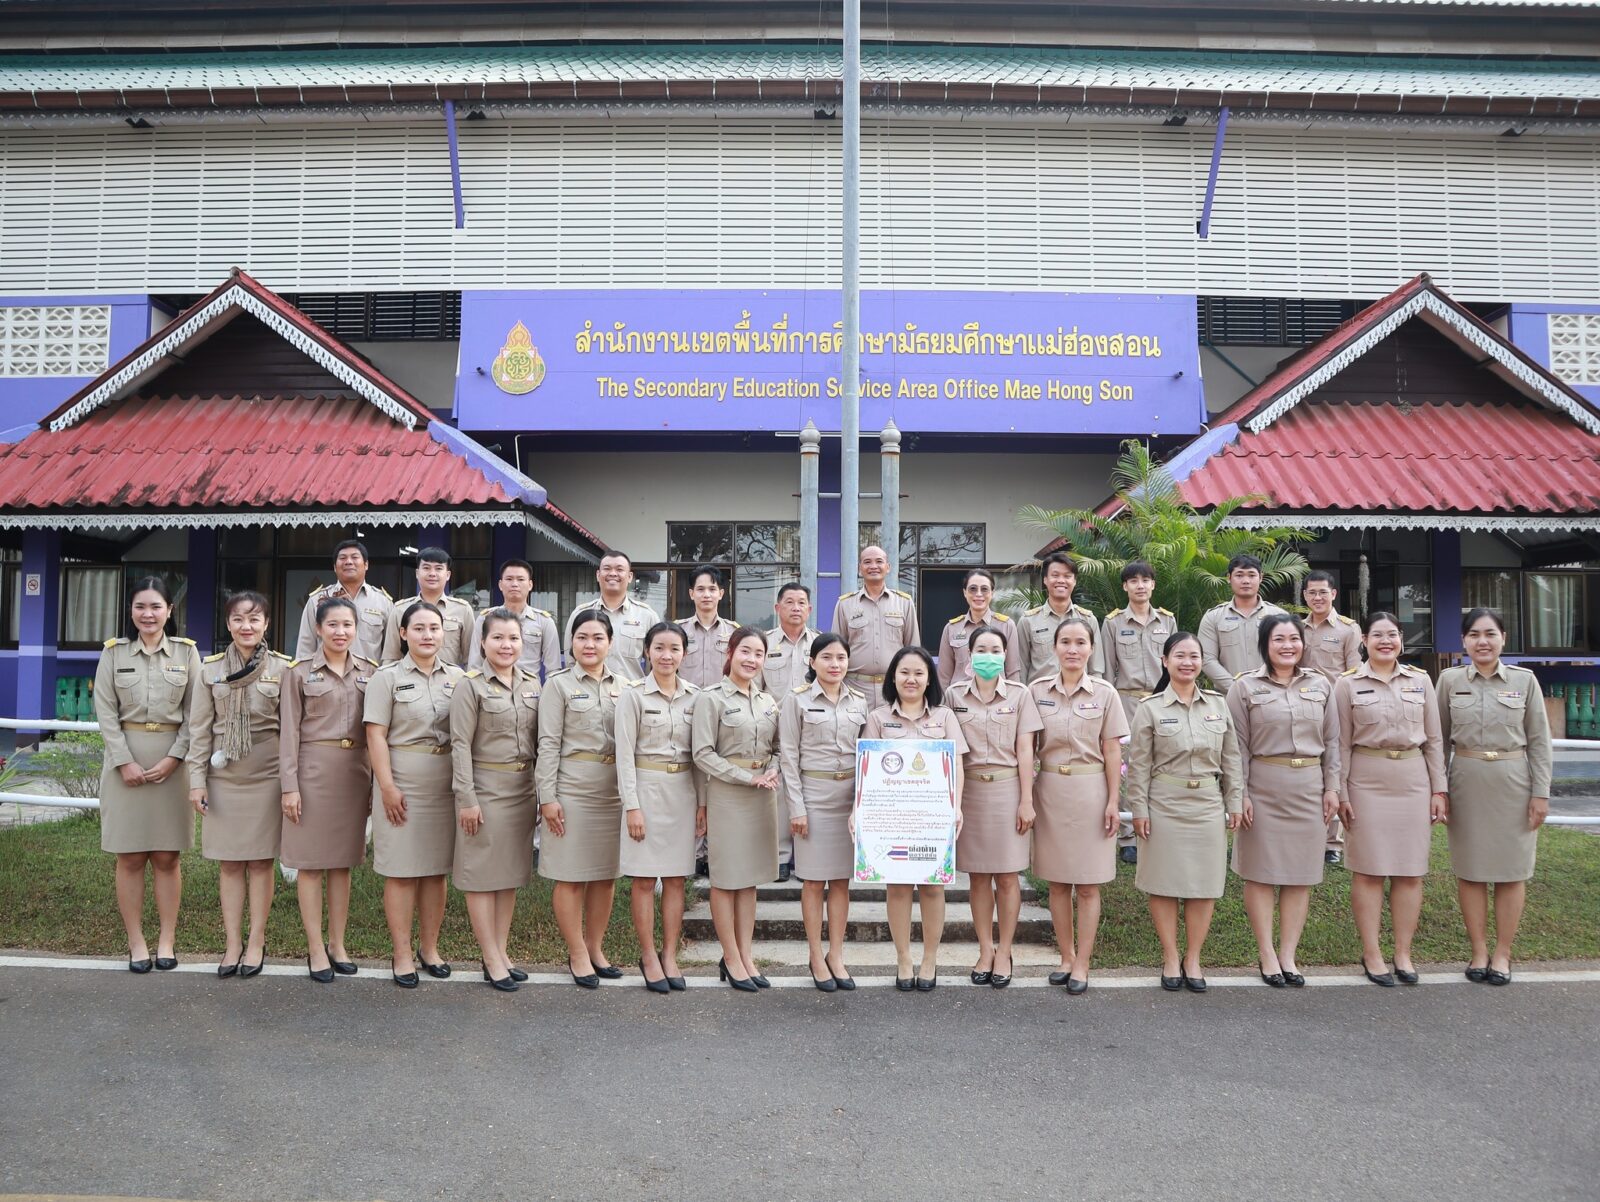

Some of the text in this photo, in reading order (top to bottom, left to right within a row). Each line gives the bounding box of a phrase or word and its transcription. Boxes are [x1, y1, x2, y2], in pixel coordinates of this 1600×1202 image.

[597, 376, 1134, 405] The Secondary Education Svice Area Office Mae Hong Son
